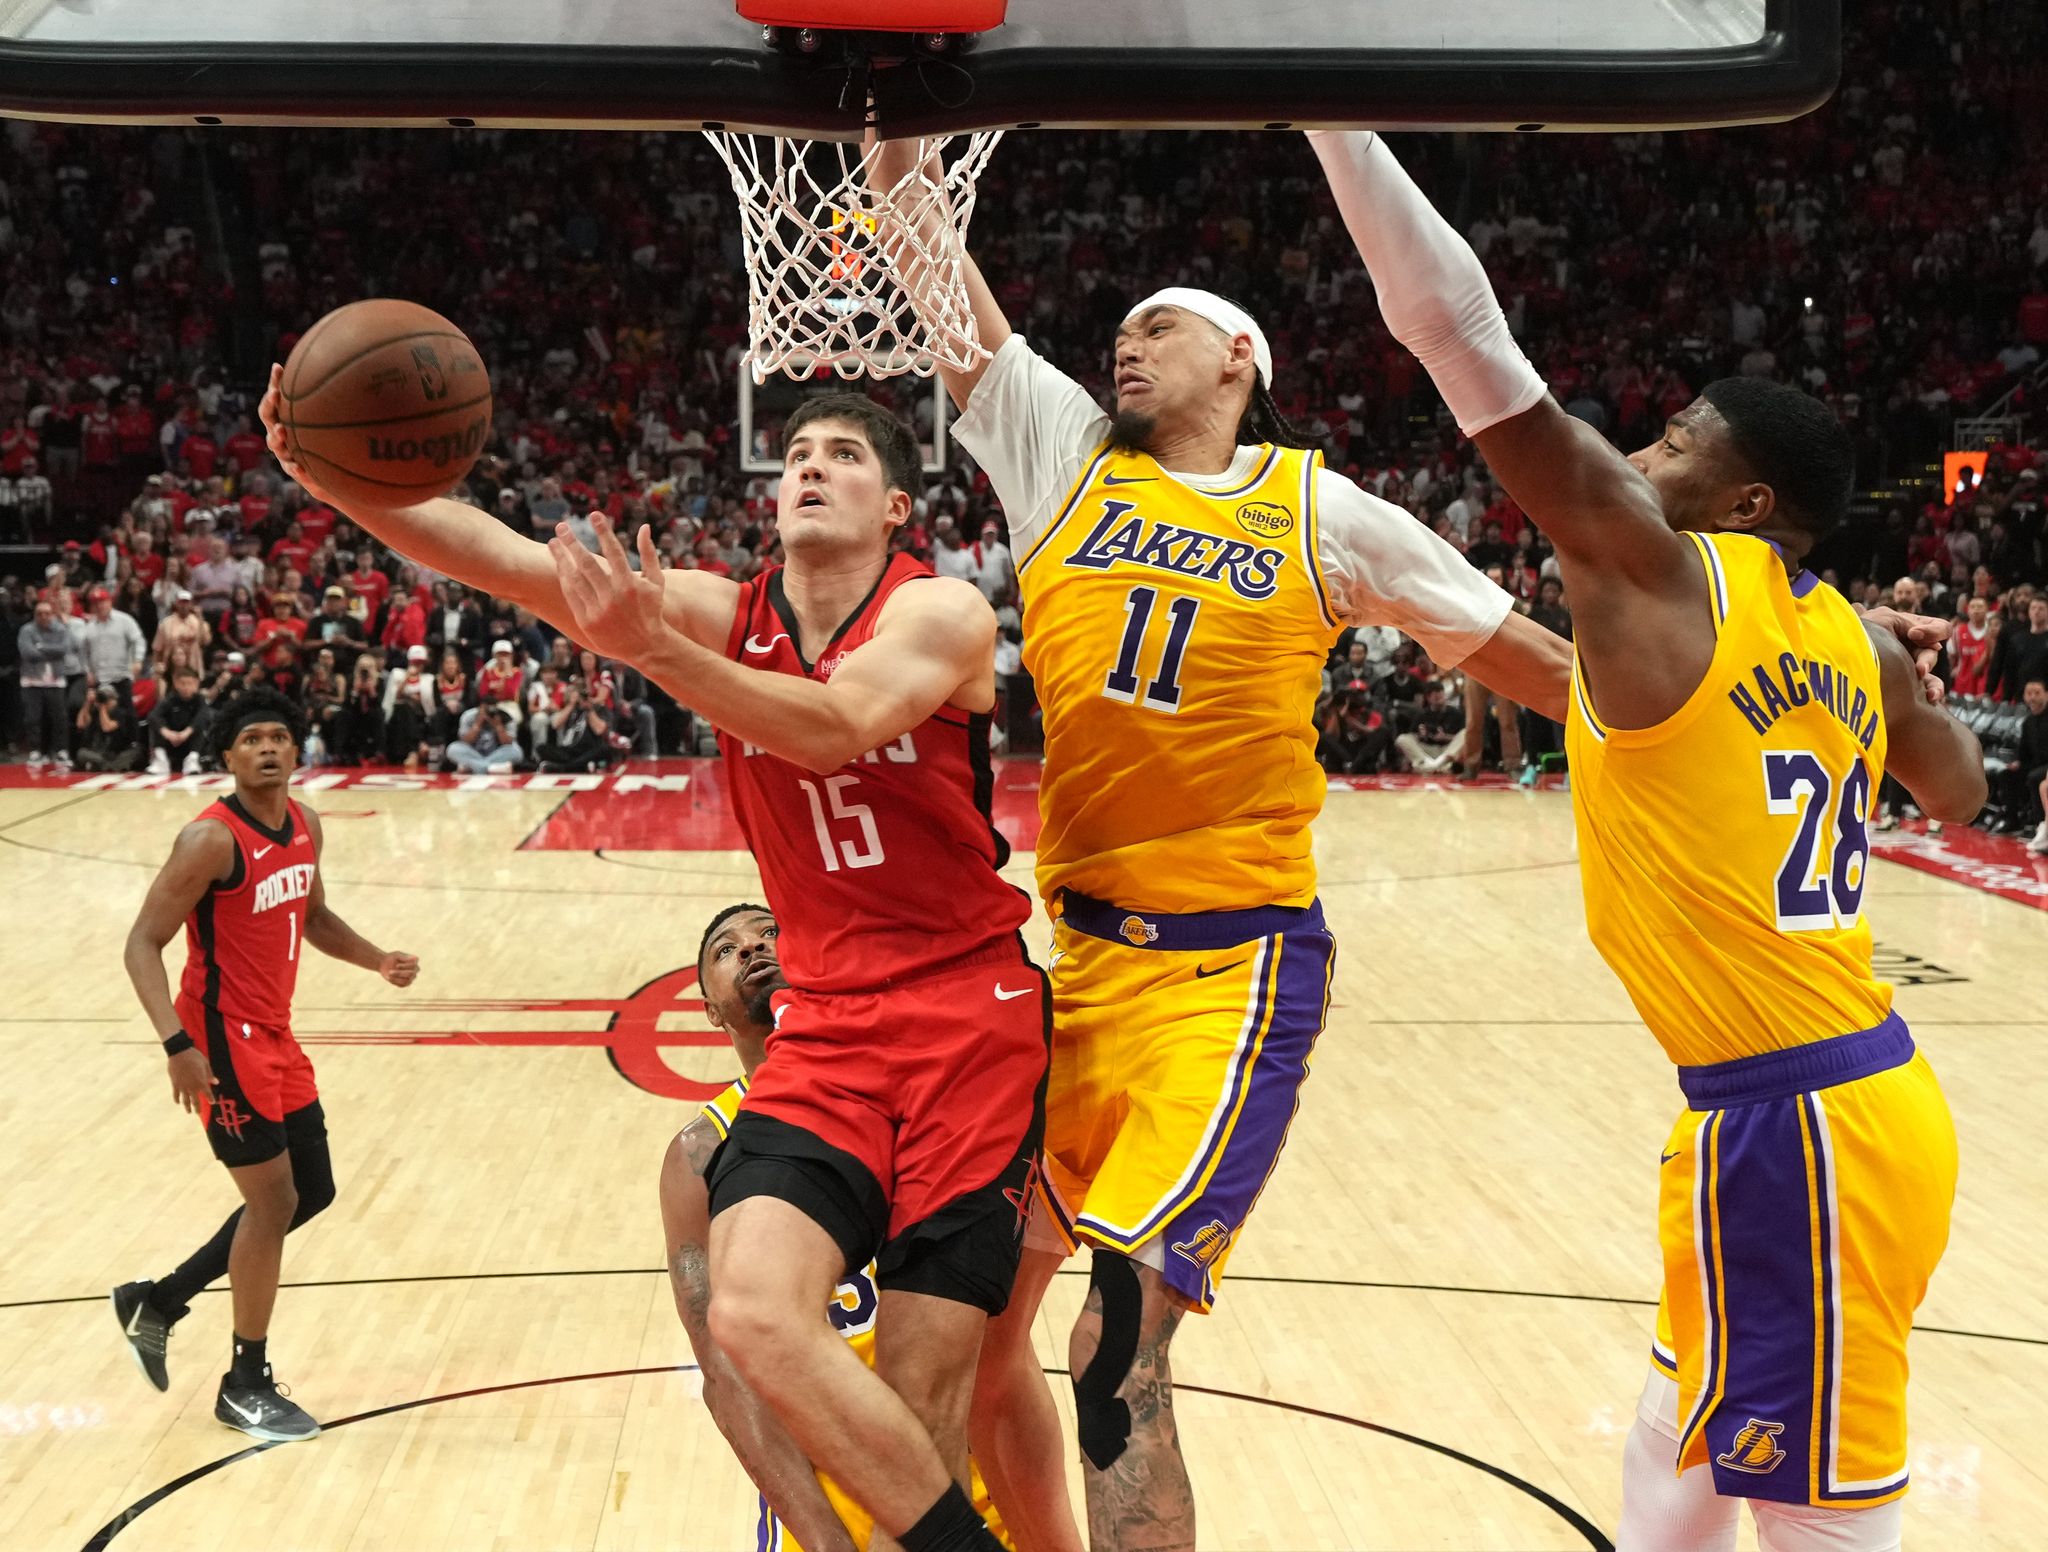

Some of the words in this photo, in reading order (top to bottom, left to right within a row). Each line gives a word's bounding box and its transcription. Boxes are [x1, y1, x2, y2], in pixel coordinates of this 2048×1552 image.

[1063, 498, 1288, 600] LAKERS
[1241, 507, 1291, 530] bibigo
[1102, 584, 1201, 714] 11
[1728, 652, 1878, 751] HACMURA
[798, 774, 886, 872] 15
[1761, 750, 1870, 932] 28
[252, 864, 315, 915] ROCKET
[288, 912, 297, 961] 1
[1119, 920, 1159, 941] LAKERS
